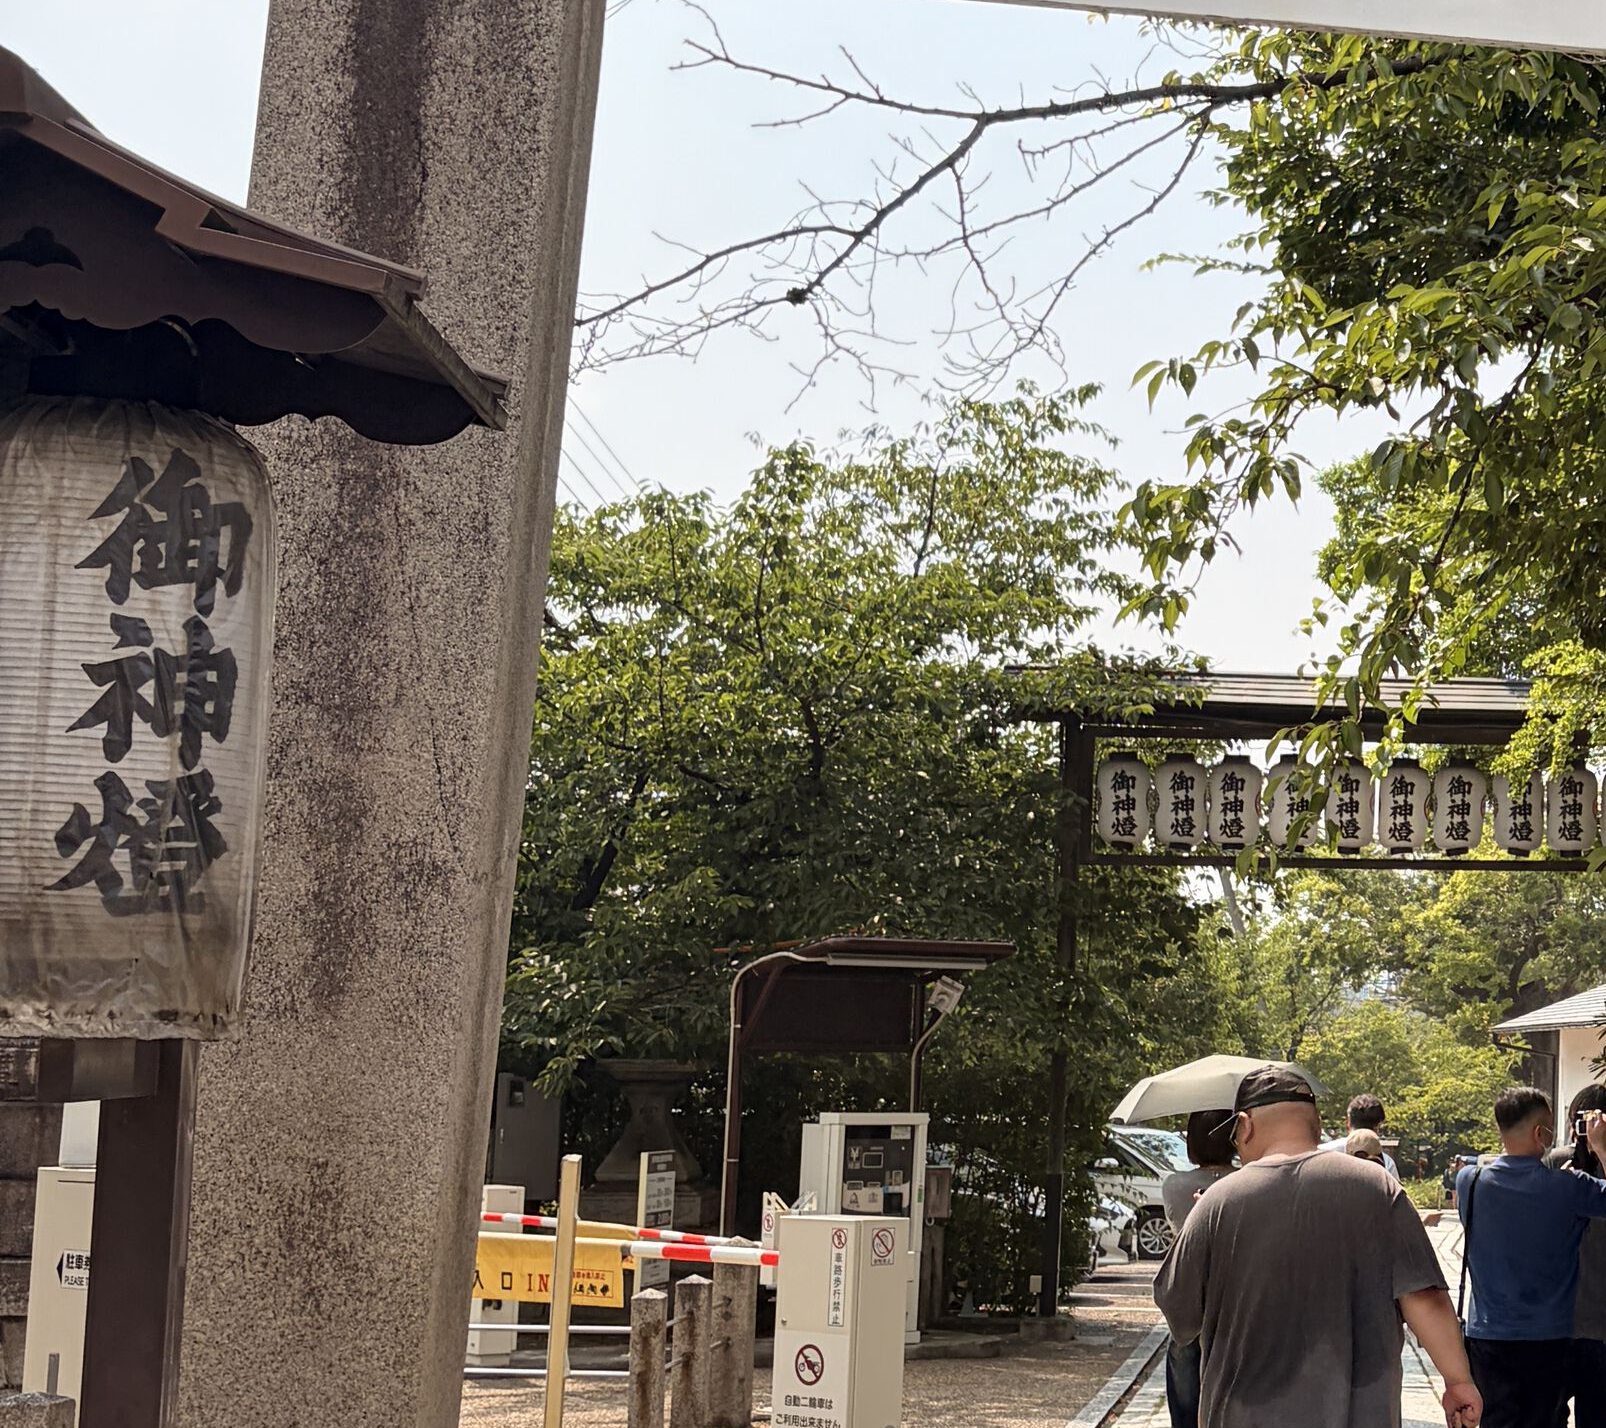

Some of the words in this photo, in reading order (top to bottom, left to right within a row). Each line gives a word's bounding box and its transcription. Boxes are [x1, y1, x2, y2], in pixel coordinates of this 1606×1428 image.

[43, 447, 254, 918] 御神燈
[1110, 770, 1137, 838] 御神燈
[1169, 770, 1196, 838] 御神燈
[1219, 772, 1246, 838] 御神燈
[1285, 772, 1310, 839] 御神
[1388, 775, 1415, 842] 御神燈
[1445, 774, 1473, 842] 御神燈
[1557, 775, 1584, 842] 御神燈
[527, 1273, 550, 1292] IN
[784, 1394, 833, 1410] 自動二輪車は
